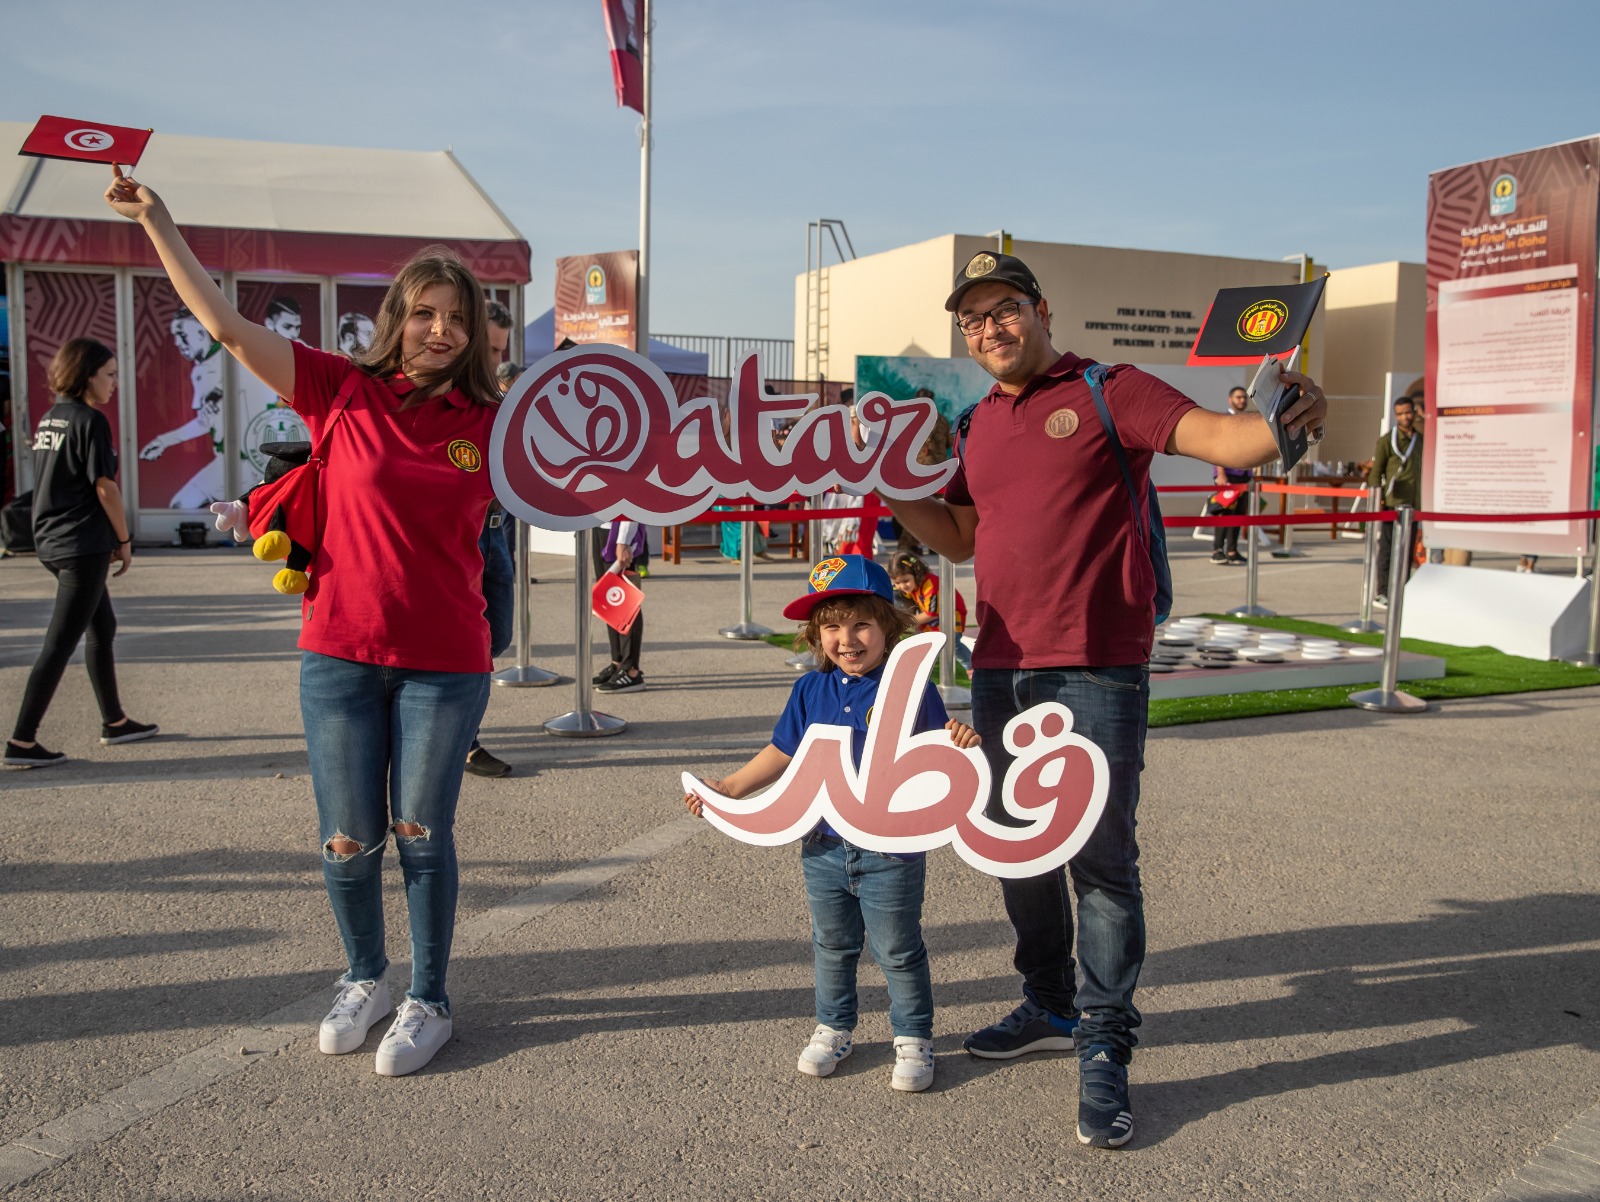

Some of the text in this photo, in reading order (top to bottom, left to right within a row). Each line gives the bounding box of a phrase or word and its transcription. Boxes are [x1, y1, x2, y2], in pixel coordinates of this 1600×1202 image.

[1461, 236, 1479, 248] The
[1480, 231, 1505, 245] Final
[1517, 235, 1547, 248] Doha
[502, 352, 949, 516] Qatar
[691, 642, 1094, 863] قطر
